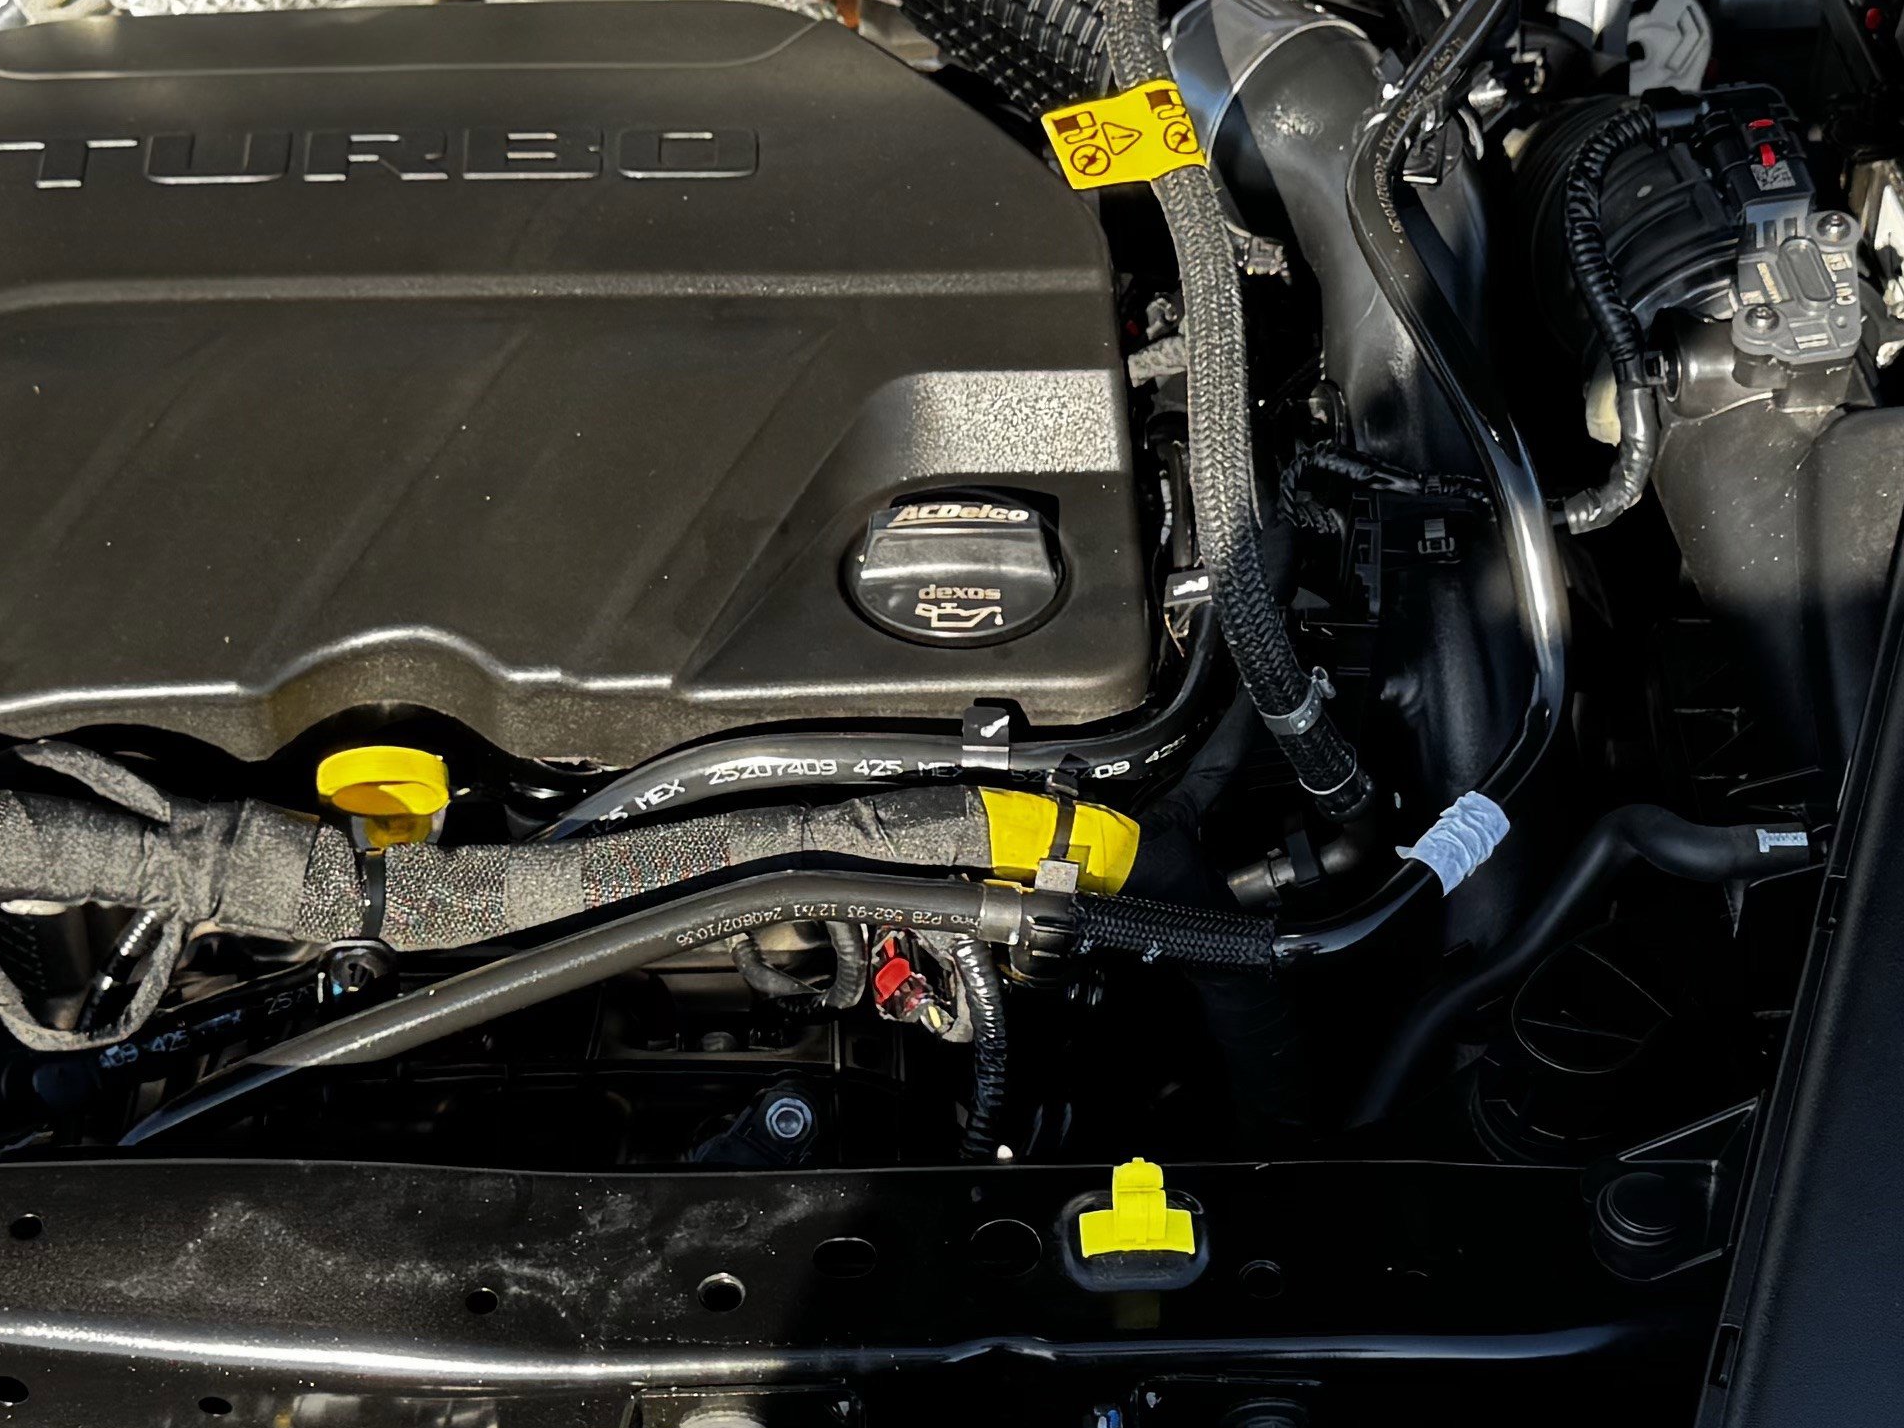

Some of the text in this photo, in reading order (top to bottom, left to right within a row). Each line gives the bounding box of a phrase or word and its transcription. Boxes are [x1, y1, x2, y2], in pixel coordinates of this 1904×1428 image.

[892, 503, 1030, 524] ACDelco
[917, 583, 1002, 600] dexos
[633, 778, 686, 810] MEX
[704, 759, 838, 786] 25207409
[853, 760, 903, 777] 425
